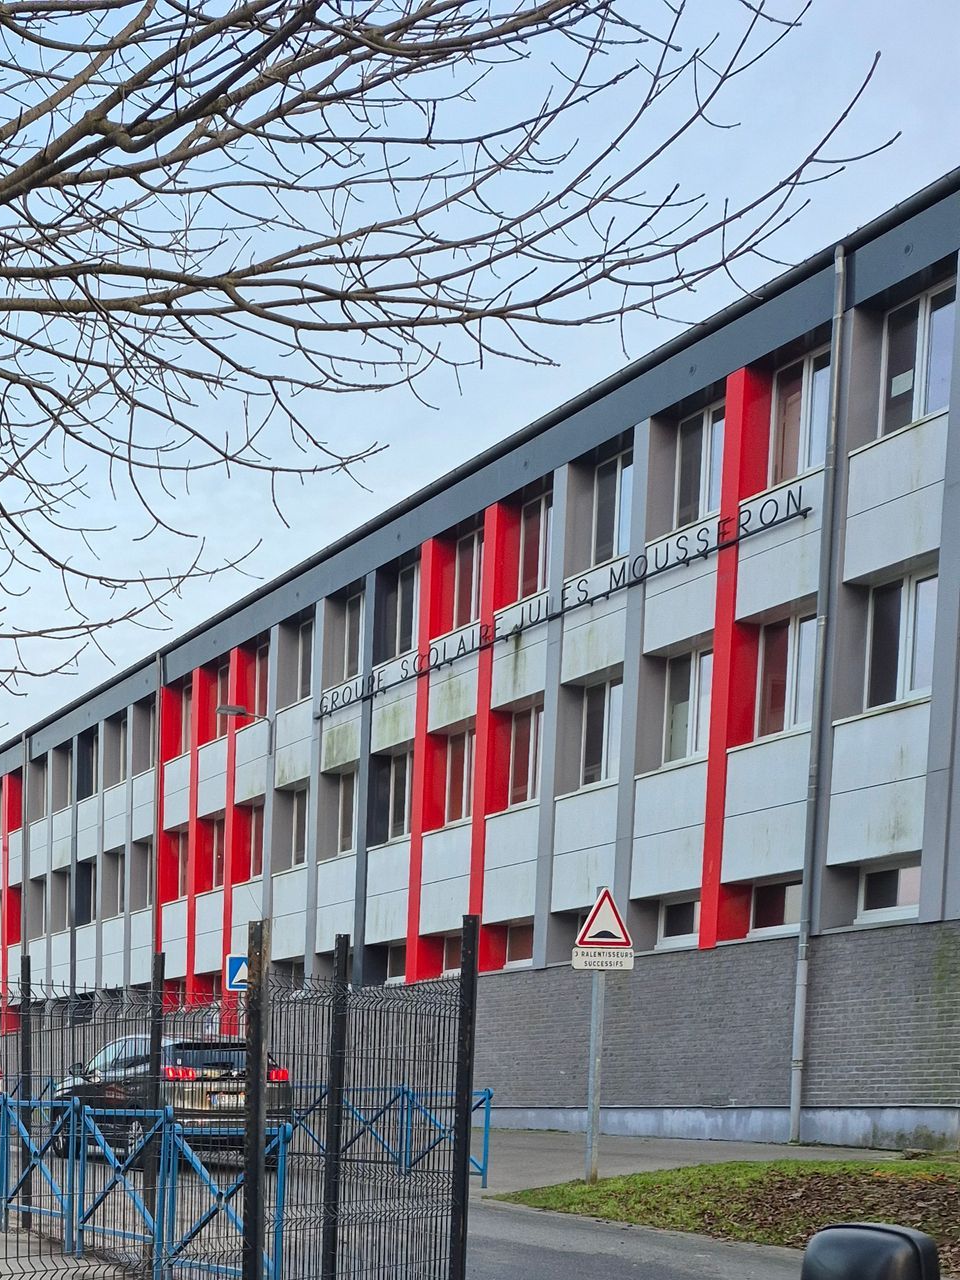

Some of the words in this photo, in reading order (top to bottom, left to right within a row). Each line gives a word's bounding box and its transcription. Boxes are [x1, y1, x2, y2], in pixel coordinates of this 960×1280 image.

[319, 669, 386, 715] GROUPE
[400, 616, 504, 681] SCOLAIRE
[519, 578, 589, 629] JULES
[609, 485, 803, 590] MOUSSERON
